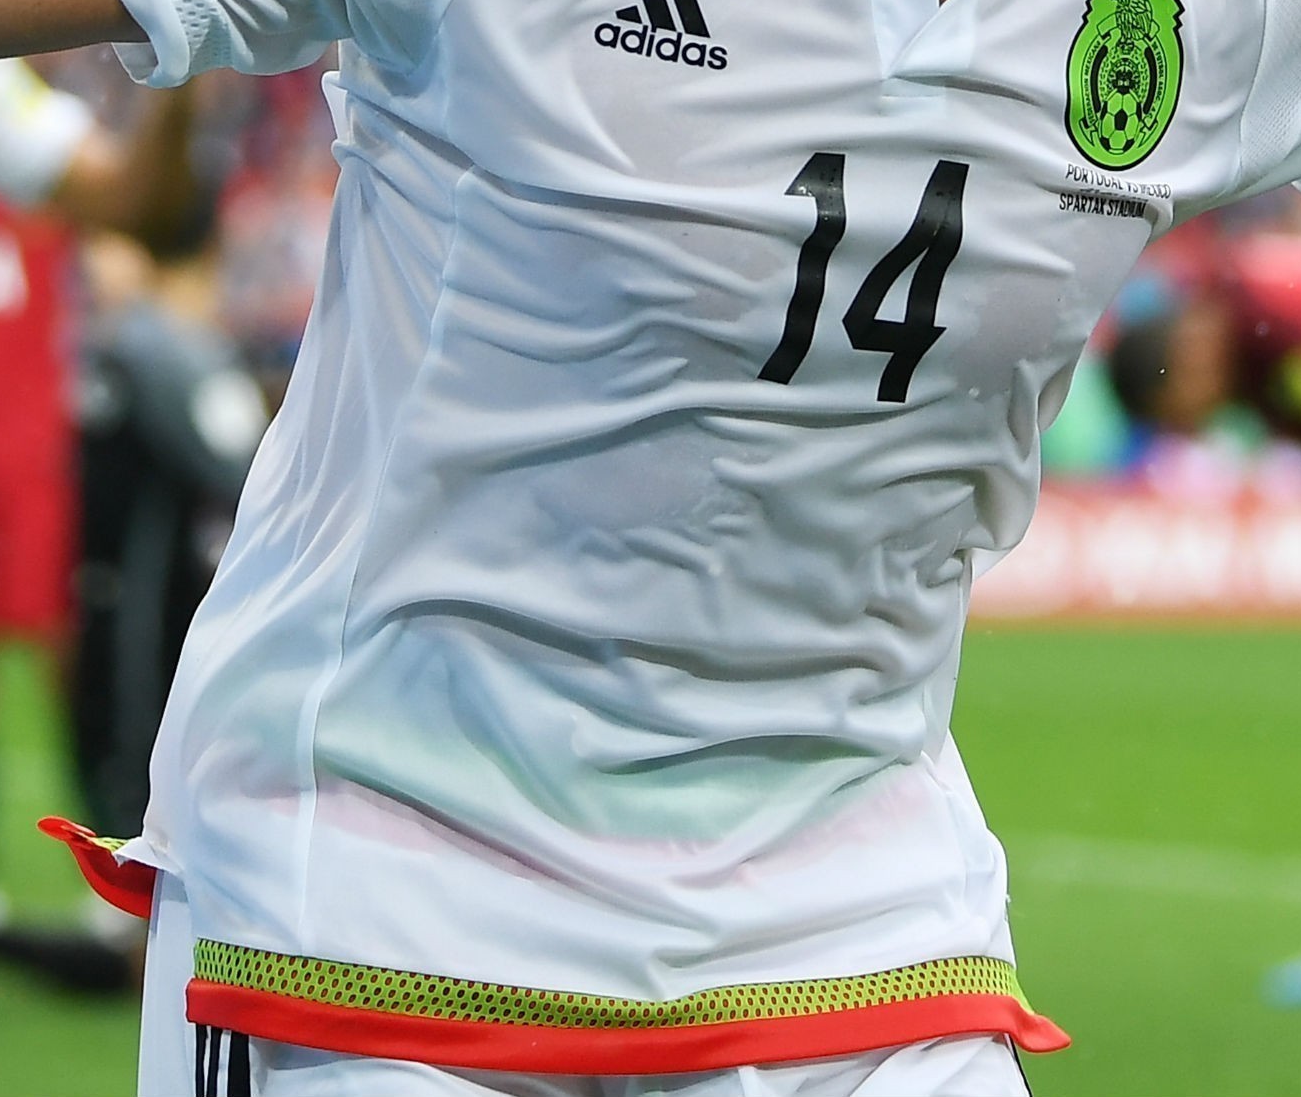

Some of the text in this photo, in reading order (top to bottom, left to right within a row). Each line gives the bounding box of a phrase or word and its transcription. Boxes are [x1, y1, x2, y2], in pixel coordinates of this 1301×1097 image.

[593, 21, 729, 71] adidas
[1059, 193, 1107, 215] SPARTAK
[1106, 198, 1149, 219] STADIUM
[757, 151, 970, 404] 14
